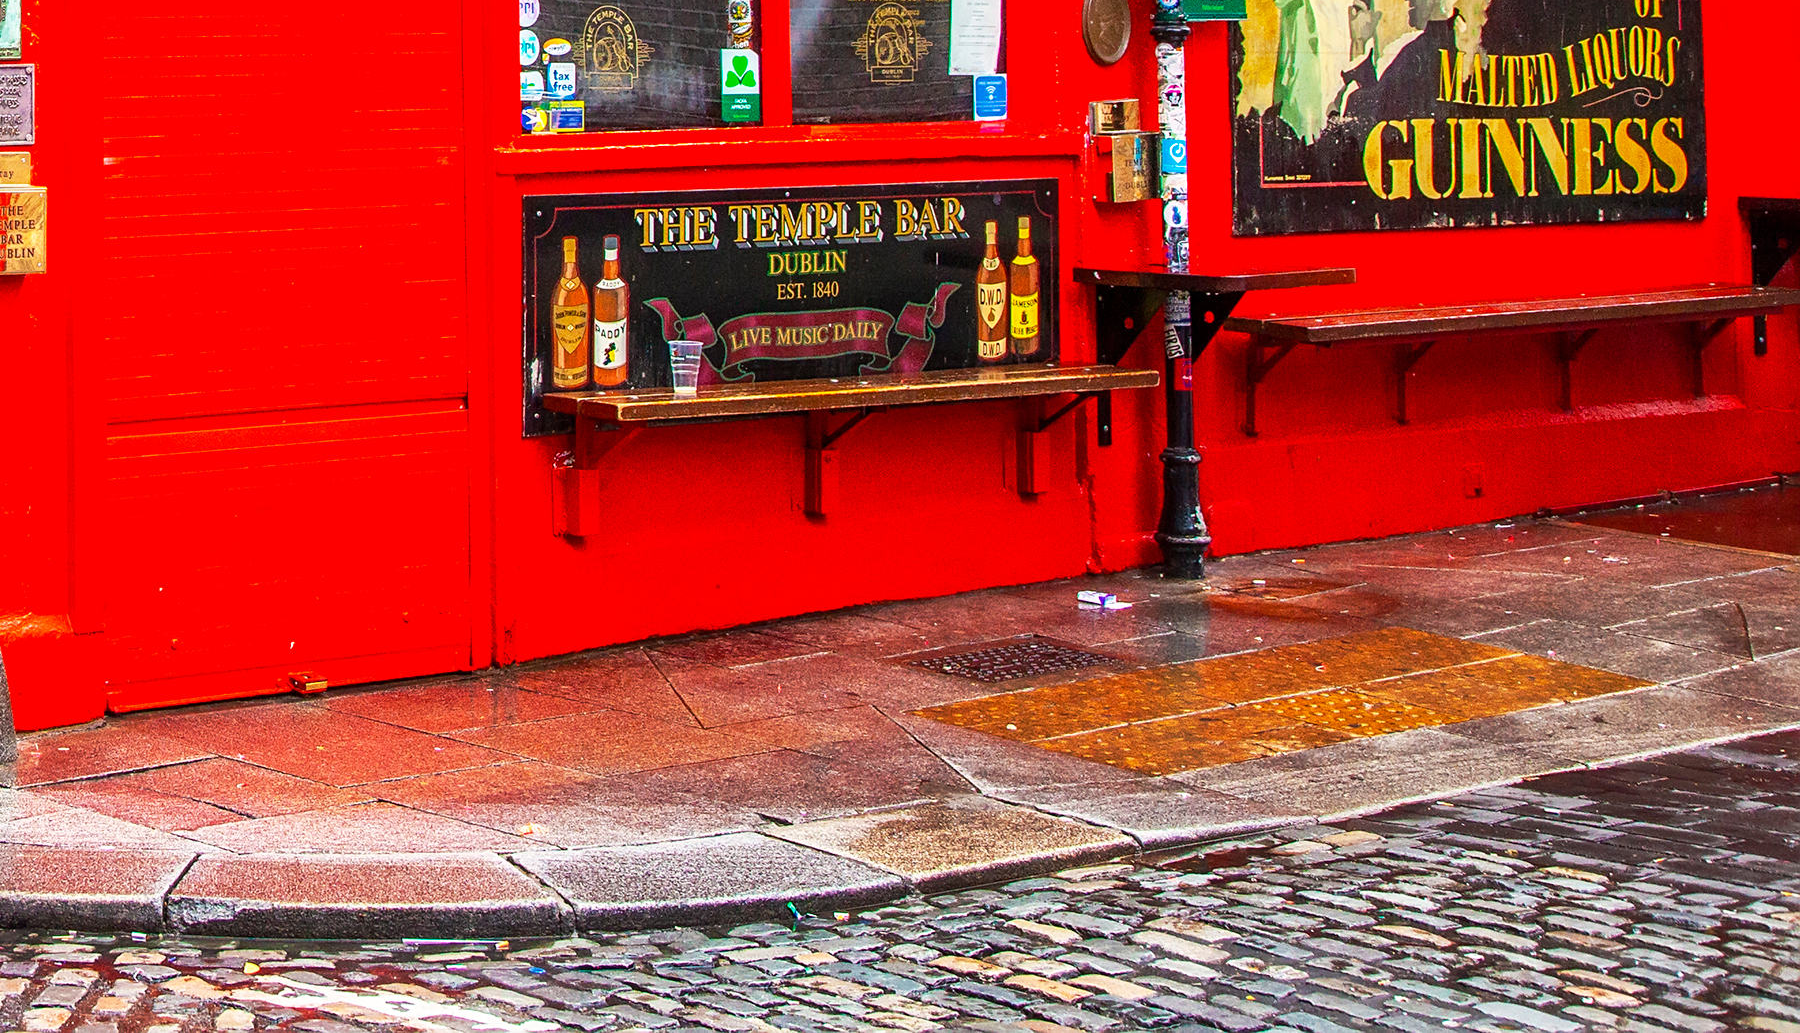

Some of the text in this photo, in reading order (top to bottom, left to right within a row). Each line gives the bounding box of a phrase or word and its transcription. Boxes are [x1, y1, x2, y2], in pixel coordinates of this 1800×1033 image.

[586, 10, 634, 51] THE TEMPLE BAR
[553, 69, 570, 80] tax
[1436, 25, 1682, 108] MALTED LIQUORS
[553, 81, 573, 92] free
[1362, 116, 1689, 200] GUINNESS
[0, 205, 24, 216] THE
[634, 197, 969, 252] THE TEMPLE BAR
[0, 234, 24, 245] BAR
[768, 250, 846, 275] DUBLIN
[776, 280, 839, 301] EST. 1840
[980, 288, 1004, 305] D.W.D.
[1012, 297, 1038, 308] JAMESON
[596, 322, 626, 339] PADDY
[731, 321, 883, 353] LIVE MUSIC DAILY
